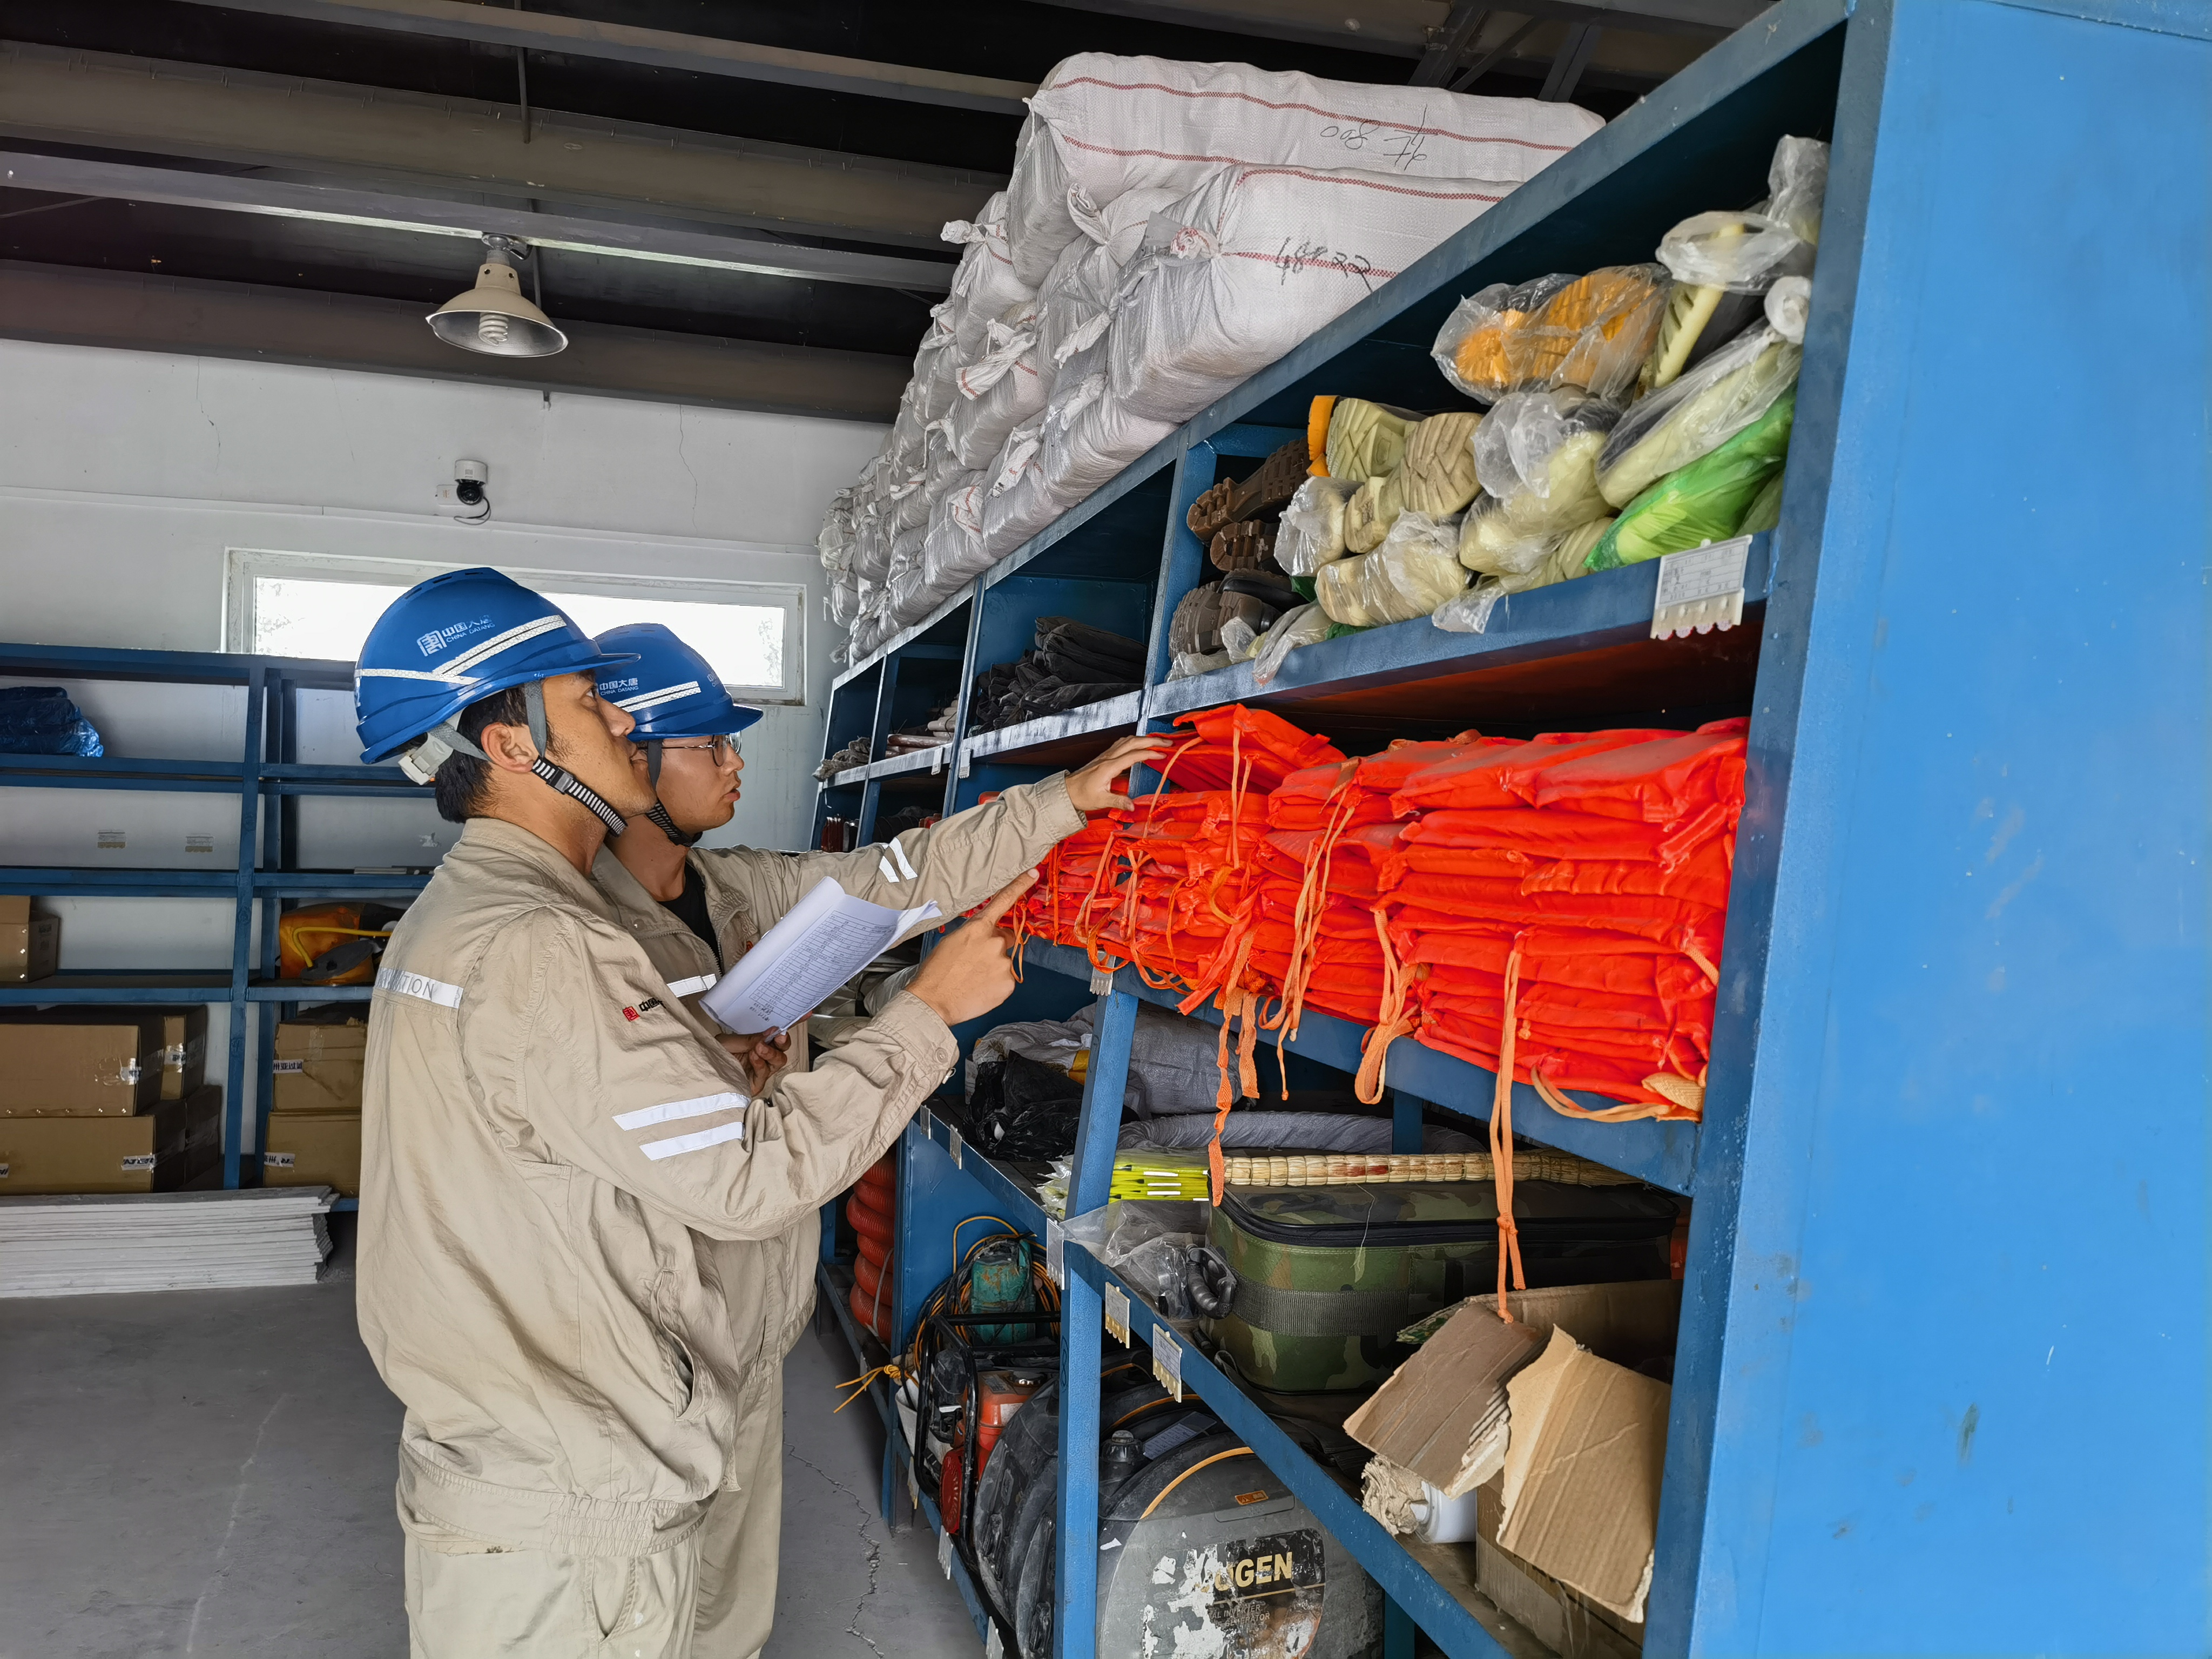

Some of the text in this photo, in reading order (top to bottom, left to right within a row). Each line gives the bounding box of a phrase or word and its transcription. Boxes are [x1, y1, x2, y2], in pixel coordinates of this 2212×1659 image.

[446, 622, 495, 642] CHINA DATANG
[599, 678, 638, 690] 中国大唐
